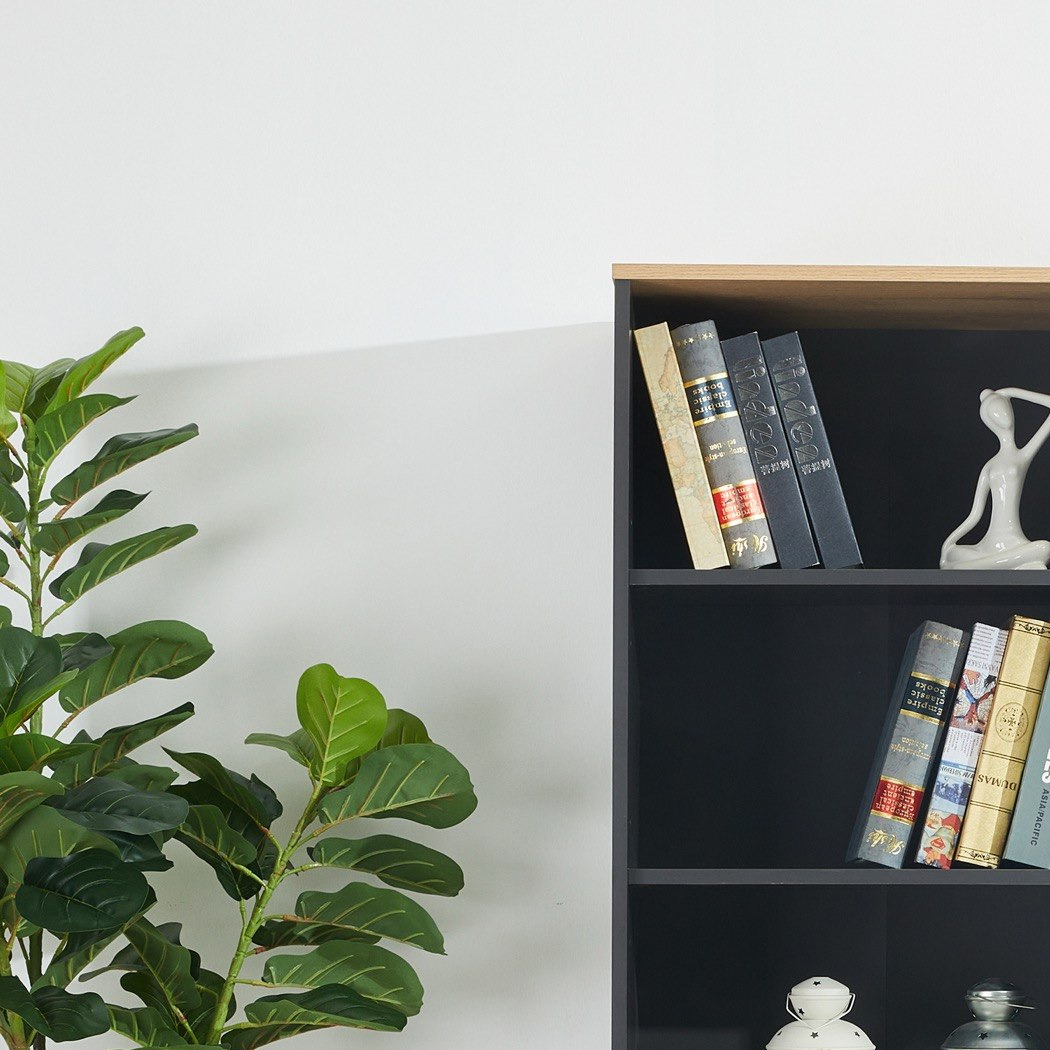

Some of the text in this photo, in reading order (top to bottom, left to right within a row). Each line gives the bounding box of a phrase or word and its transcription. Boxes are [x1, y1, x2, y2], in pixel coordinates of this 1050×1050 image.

[692, 381, 725, 396] books
[693, 391, 728, 405] classic
[694, 400, 732, 415] Empire
[732, 355, 778, 464] linden
[772, 354, 819, 464] linden
[910, 690, 945, 705] classic
[915, 681, 946, 698] books
[906, 698, 943, 716] Empire
[886, 783, 916, 796] empire
[977, 772, 1018, 792] DUMAS
[879, 796, 914, 813] classical
[882, 789, 915, 804] ancient
[875, 803, 915, 820] European
